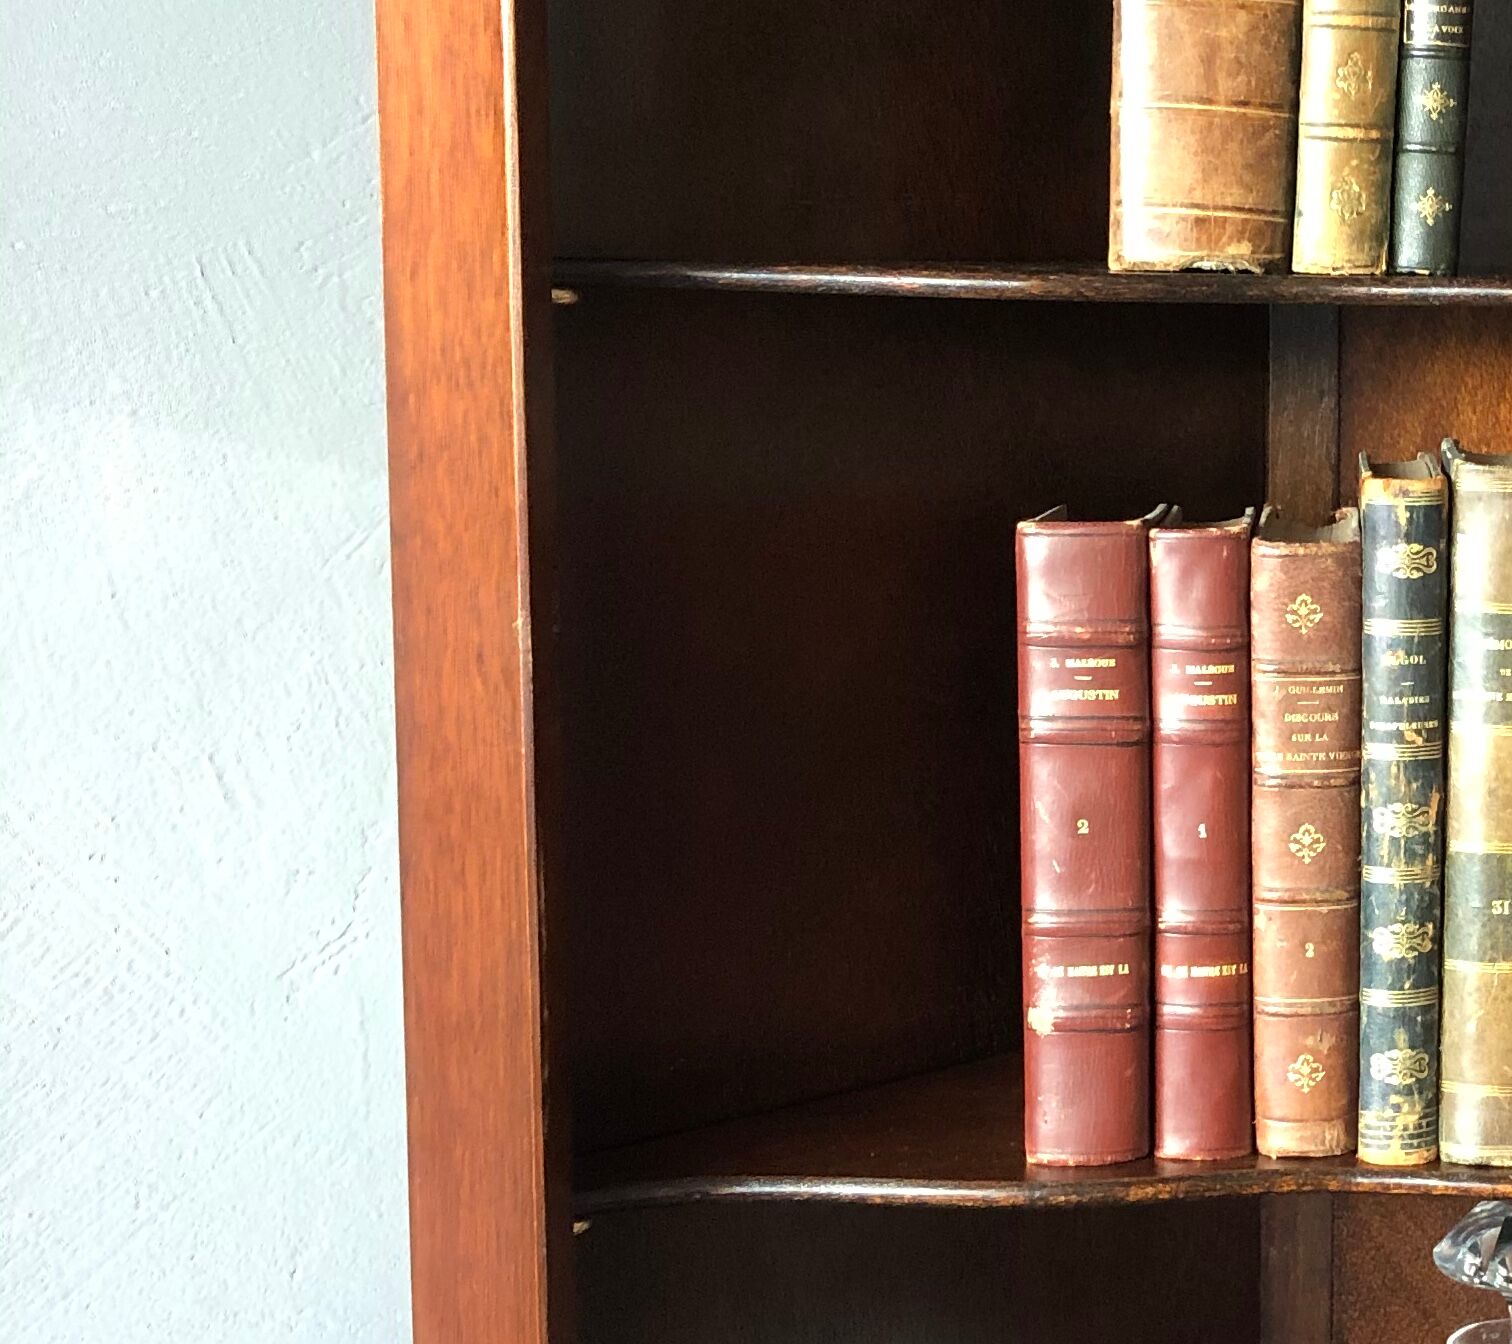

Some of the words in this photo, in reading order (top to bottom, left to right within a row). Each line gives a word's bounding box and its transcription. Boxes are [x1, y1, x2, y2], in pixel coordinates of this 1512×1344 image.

[1051, 689, 1119, 701] GUSTIN
[1284, 712, 1339, 723] DISCOURS
[1291, 733, 1312, 742] SUR
[1315, 733, 1329, 742] LA
[1076, 819, 1090, 836] 2
[1198, 823, 1208, 839] 1
[1491, 899, 1511, 917] 31
[1304, 942, 1316, 958] 2
